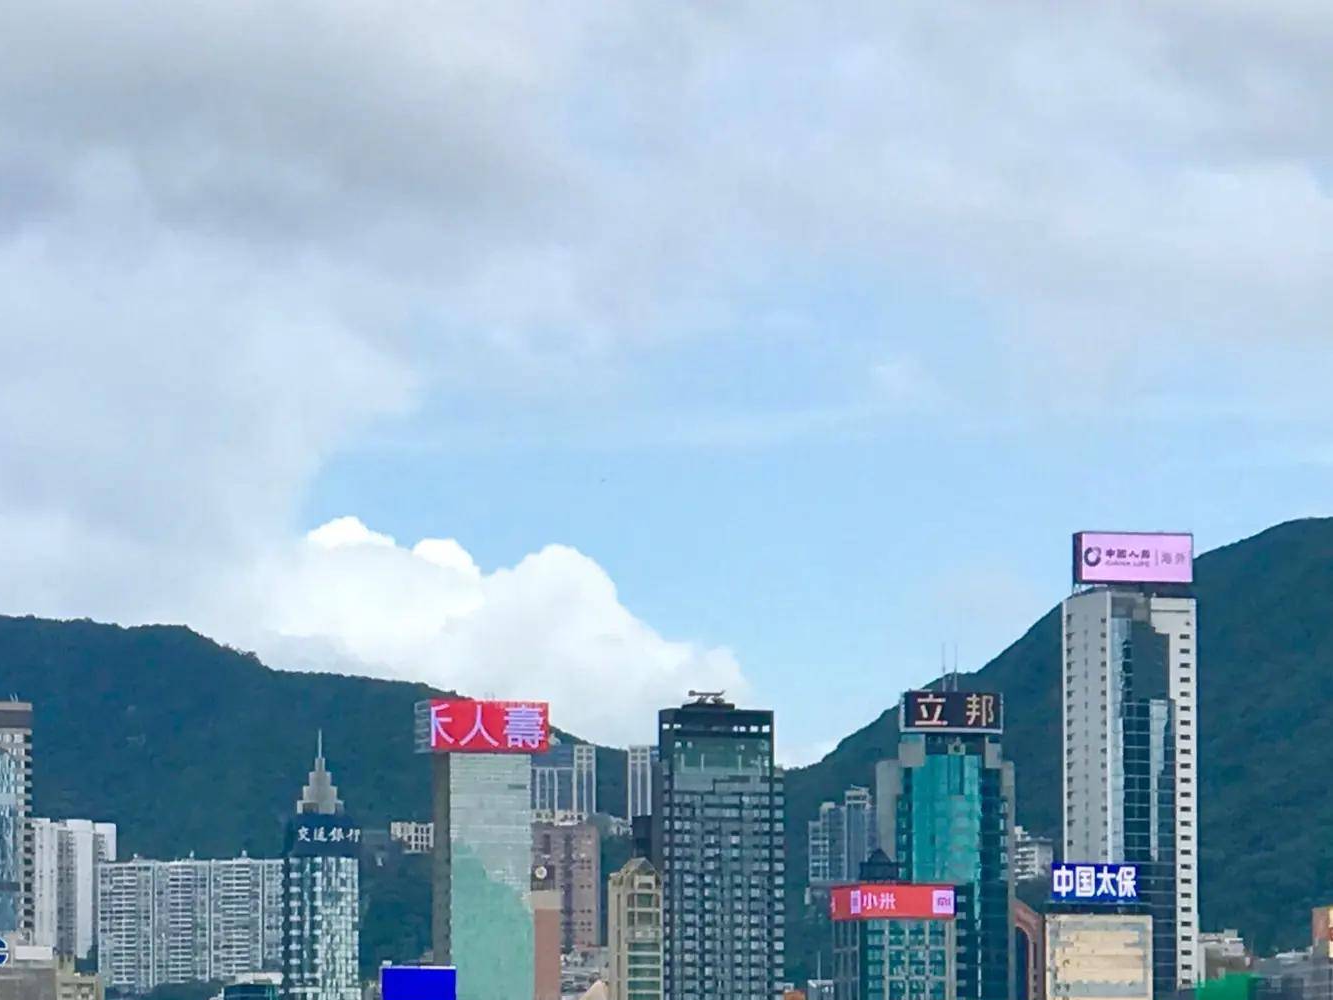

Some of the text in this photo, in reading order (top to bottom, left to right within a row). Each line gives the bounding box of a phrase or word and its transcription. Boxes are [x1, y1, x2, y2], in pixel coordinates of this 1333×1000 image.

[914, 693, 994, 727] 立邦
[1053, 865, 1137, 897] 中国太保
[862, 892, 897, 911] 小米
